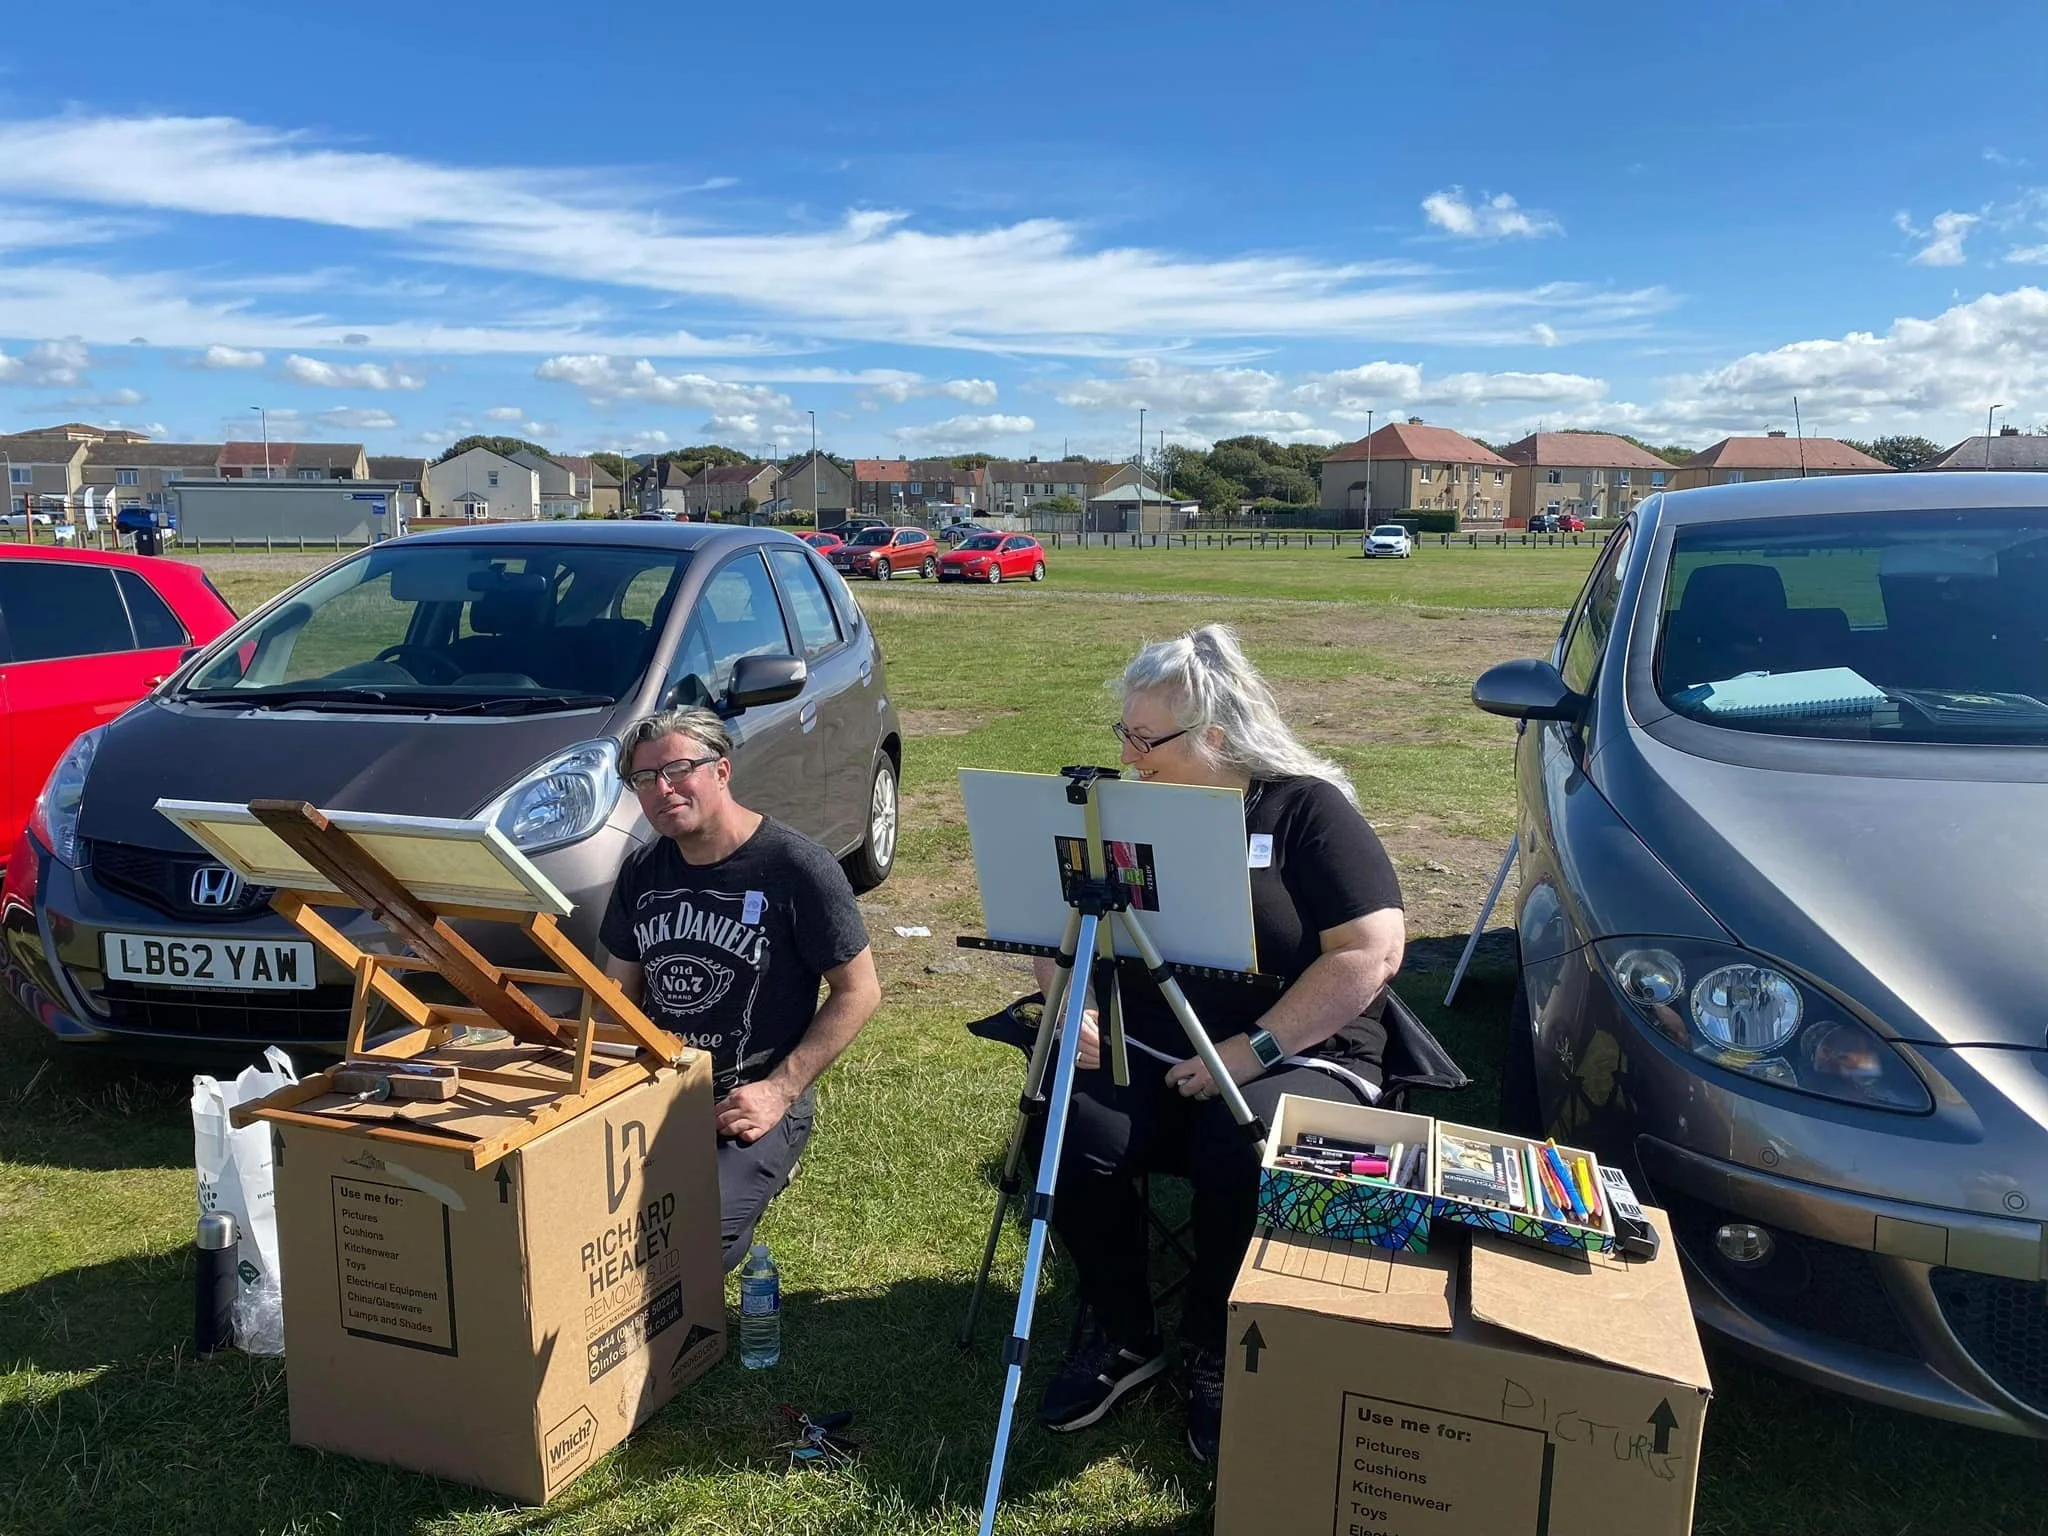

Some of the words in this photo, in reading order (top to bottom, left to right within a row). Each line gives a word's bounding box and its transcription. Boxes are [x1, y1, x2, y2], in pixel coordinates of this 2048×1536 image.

[633, 911, 672, 959] JACK
[120, 938, 215, 978] LB62
[224, 945, 298, 982] YAW
[670, 965, 693, 975] Old
[340, 1186, 361, 1200] Use
[364, 1191, 381, 1203] me
[384, 1192, 403, 1207] for:
[342, 1208, 378, 1223] Pictures
[343, 1225, 384, 1241] Cushions
[580, 1192, 675, 1273] RICHARD
[344, 1241, 400, 1260] Kitchenwear
[589, 1222, 671, 1299] HEALEY
[345, 1258, 366, 1271] Toys
[346, 1274, 387, 1292] Electrical
[389, 1282, 438, 1300] Equipment
[347, 1292, 423, 1314] China/Glassware
[348, 1307, 378, 1322] Lamps
[380, 1315, 397, 1326] and
[399, 1318, 433, 1333] Shades
[1357, 1407, 1394, 1426] Use
[1400, 1417, 1430, 1434] me
[1437, 1423, 1472, 1443] for:
[549, 1418, 592, 1464] Which?
[1355, 1436, 1421, 1460] Pictures
[1353, 1458, 1427, 1485] Cushions
[1352, 1480, 1452, 1512] Kitchenwear
[1351, 1501, 1388, 1521] Toys
